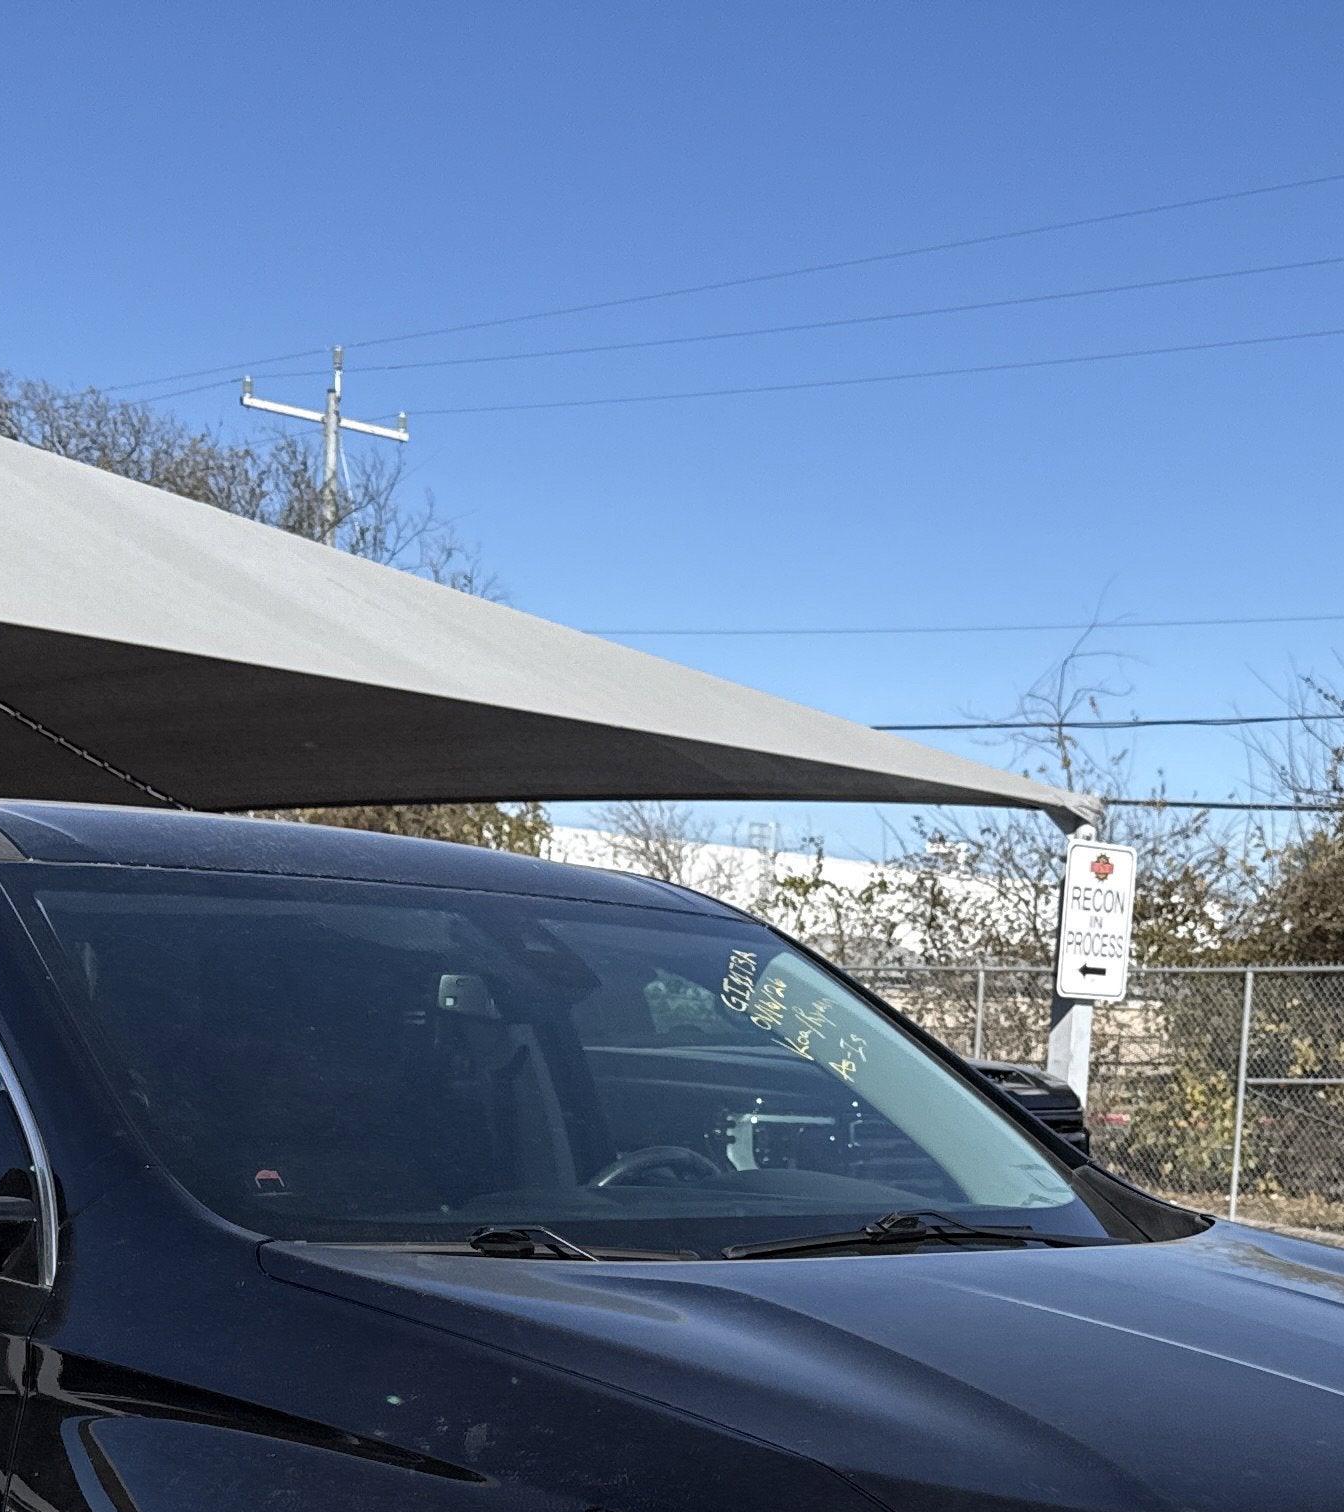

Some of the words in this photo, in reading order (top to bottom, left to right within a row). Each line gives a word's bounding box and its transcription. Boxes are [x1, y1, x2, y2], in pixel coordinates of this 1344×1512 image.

[1071, 885, 1125, 914] RECON
[1089, 915, 1103, 930] IN
[1066, 930, 1124, 959] PROCESS
